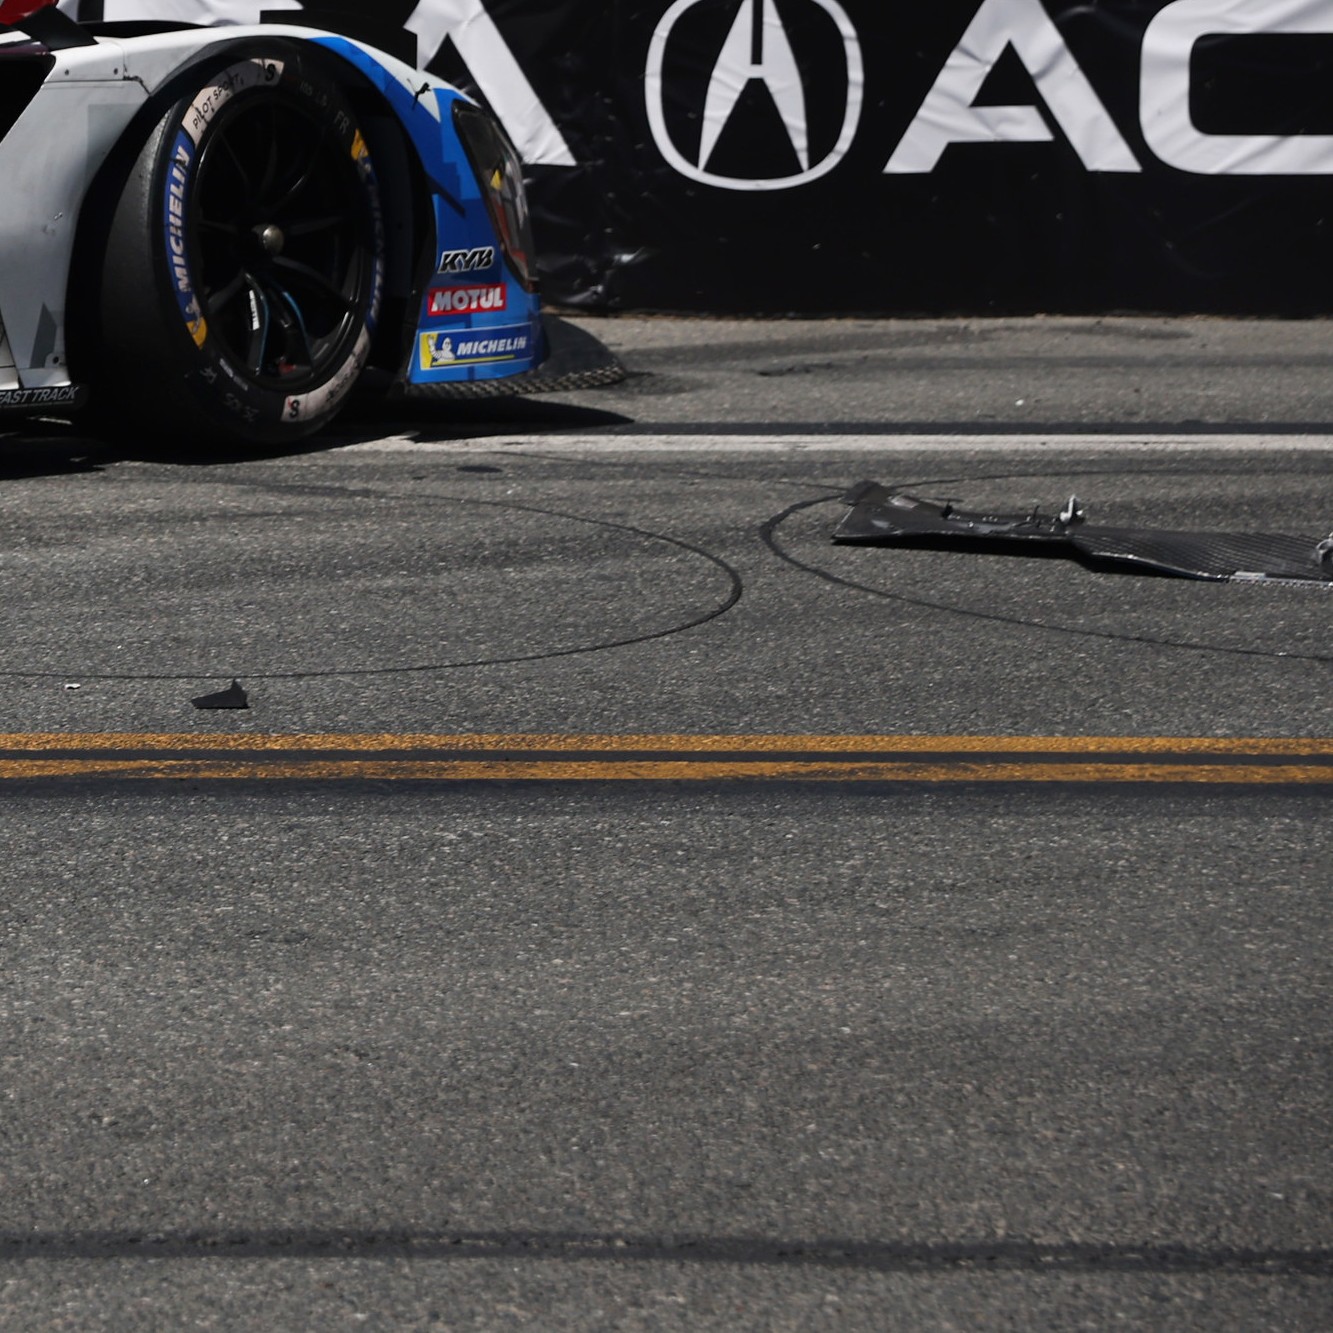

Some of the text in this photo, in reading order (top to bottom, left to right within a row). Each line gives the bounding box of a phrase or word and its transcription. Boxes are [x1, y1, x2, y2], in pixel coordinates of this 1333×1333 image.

[192, 95, 212, 130] PILOT
[165, 145, 191, 293] MICHELIN
[437, 246, 495, 273] KYB
[430, 286, 505, 313] MOTUL
[456, 335, 528, 357] MICHELIN
[32, 386, 79, 404] TRACK
